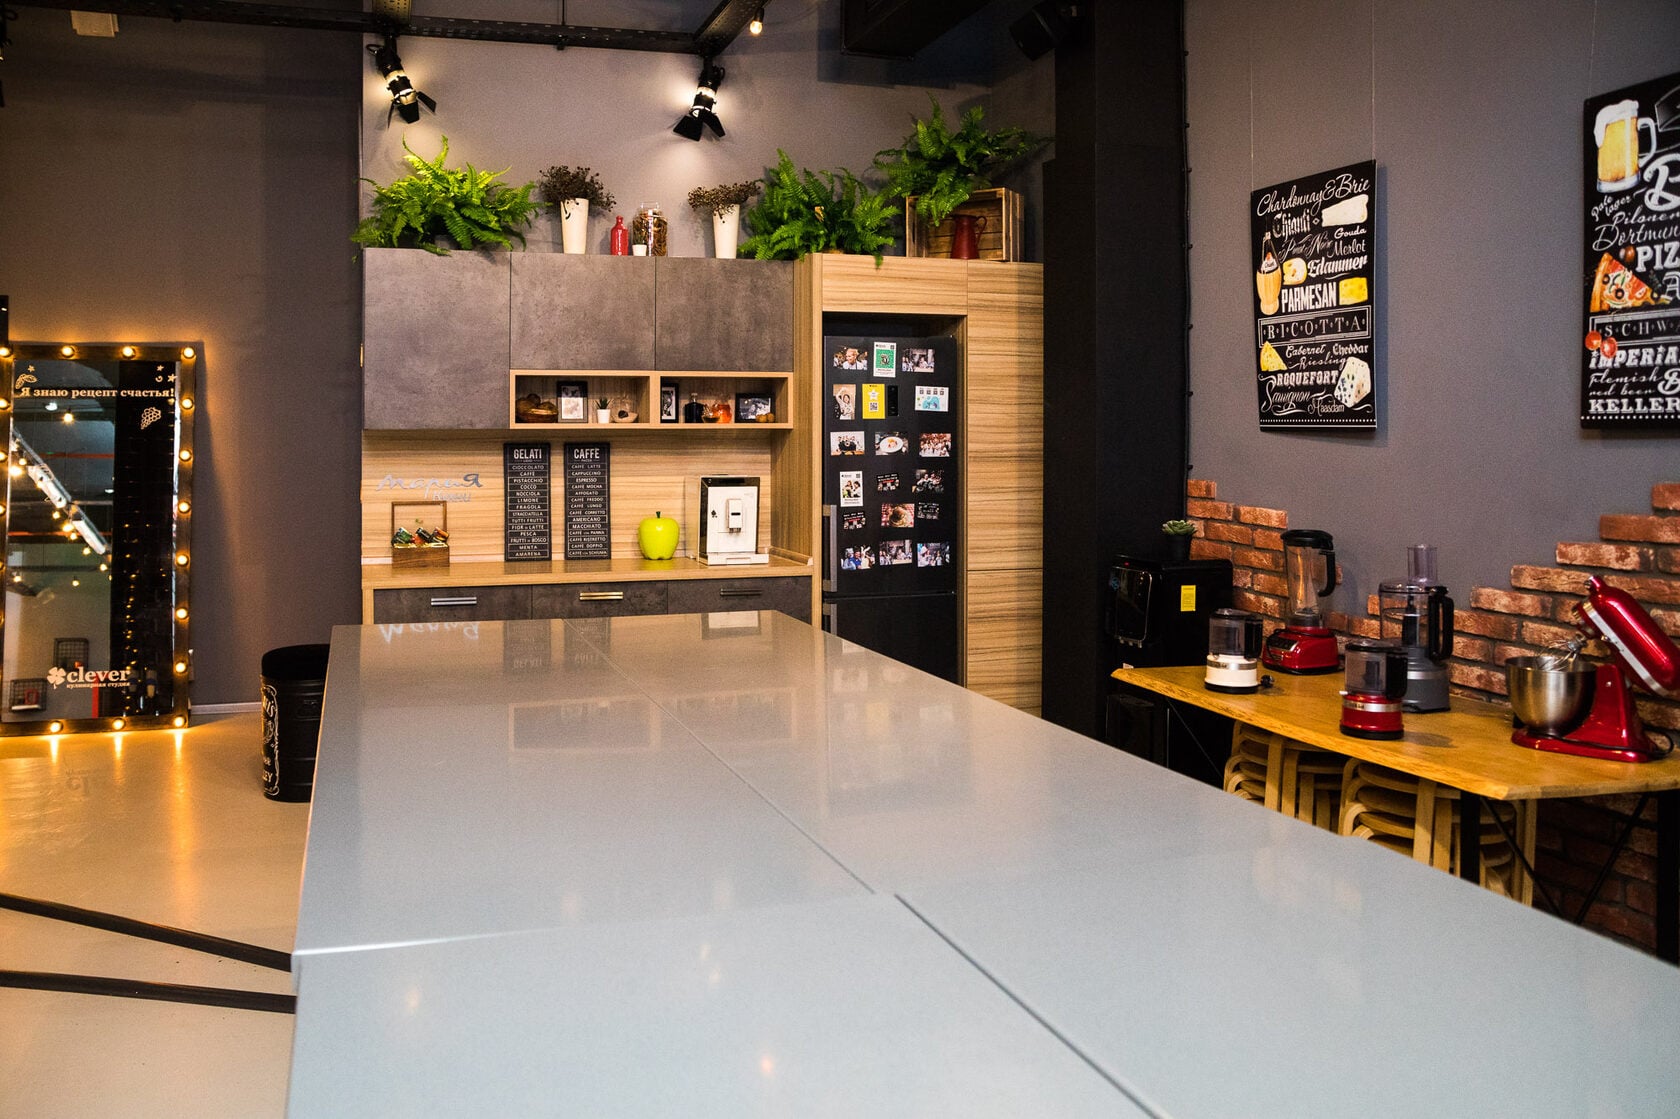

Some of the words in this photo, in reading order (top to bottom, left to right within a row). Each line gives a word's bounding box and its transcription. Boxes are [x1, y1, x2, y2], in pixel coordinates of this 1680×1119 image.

[1257, 185, 1323, 216] Chardonnay
[1322, 180, 1336, 200] &
[1335, 173, 1370, 198] Brie
[1272, 209, 1311, 240] Chianti
[1334, 225, 1367, 239] Gouda
[1327, 239, 1366, 258] Merlot
[1307, 255, 1368, 277] Edammer
[1281, 282, 1337, 313] PARMESAN
[1604, 320, 1680, 337] SCHW
[1285, 344, 1326, 358] Cabernet
[1332, 343, 1369, 356] Cheddar
[1589, 345, 1680, 369] IMPERIA
[1290, 351, 1347, 370] Riesling
[1276, 370, 1339, 389] ROQUEFORT
[1588, 366, 1662, 388] Flemish
[20, 387, 30, 397] Я
[33, 388, 68, 397] знаю
[71, 388, 118, 399] рецепт
[120, 388, 175, 397] счастья!
[1259, 375, 1311, 413] Sauvignon
[1589, 383, 1616, 396] red
[1620, 383, 1656, 396] beer
[513, 448, 542, 459] GELATI
[66, 666, 131, 683] clever
